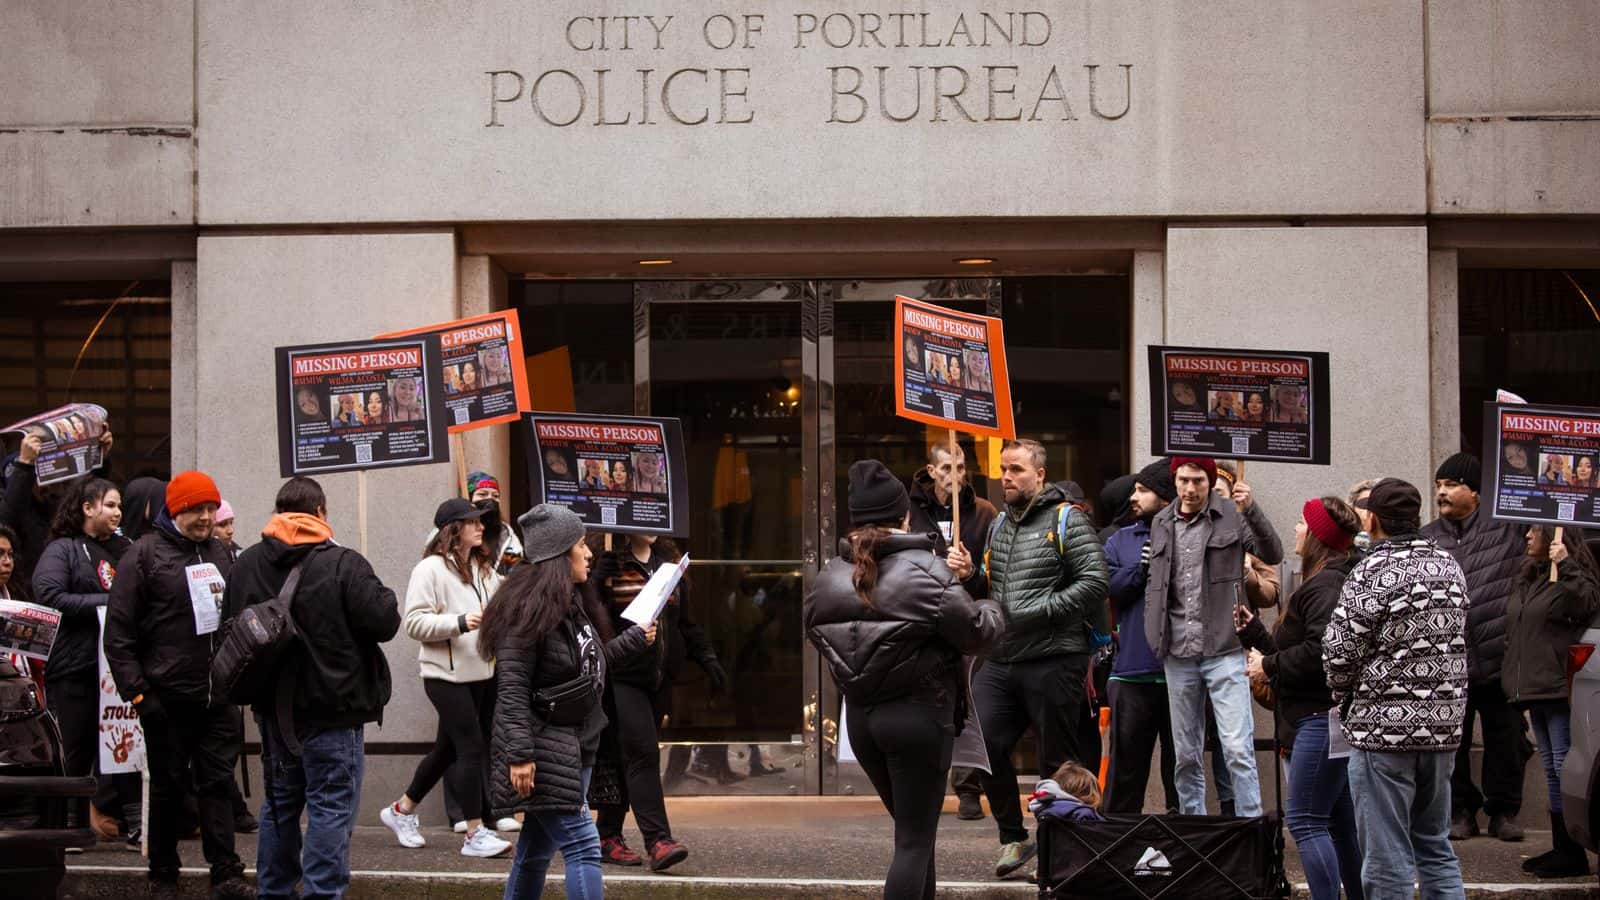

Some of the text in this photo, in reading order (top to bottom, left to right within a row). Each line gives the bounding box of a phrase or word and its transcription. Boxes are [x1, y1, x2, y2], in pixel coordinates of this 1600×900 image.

[565, 12, 1051, 51] CITY OF PORTLAND
[485, 64, 1133, 127] POLICE BUREAU
[453, 324, 502, 344] PERSON
[905, 310, 984, 339] MISSING PERSON
[295, 351, 417, 373] MISSING PERSON
[1170, 358, 1304, 376] MISSING PERSON
[328, 375, 355, 386] WILMA
[356, 373, 387, 384] ACOSTA
[540, 424, 658, 442] MISSING PERSON
[1505, 416, 1570, 433] MISSING
